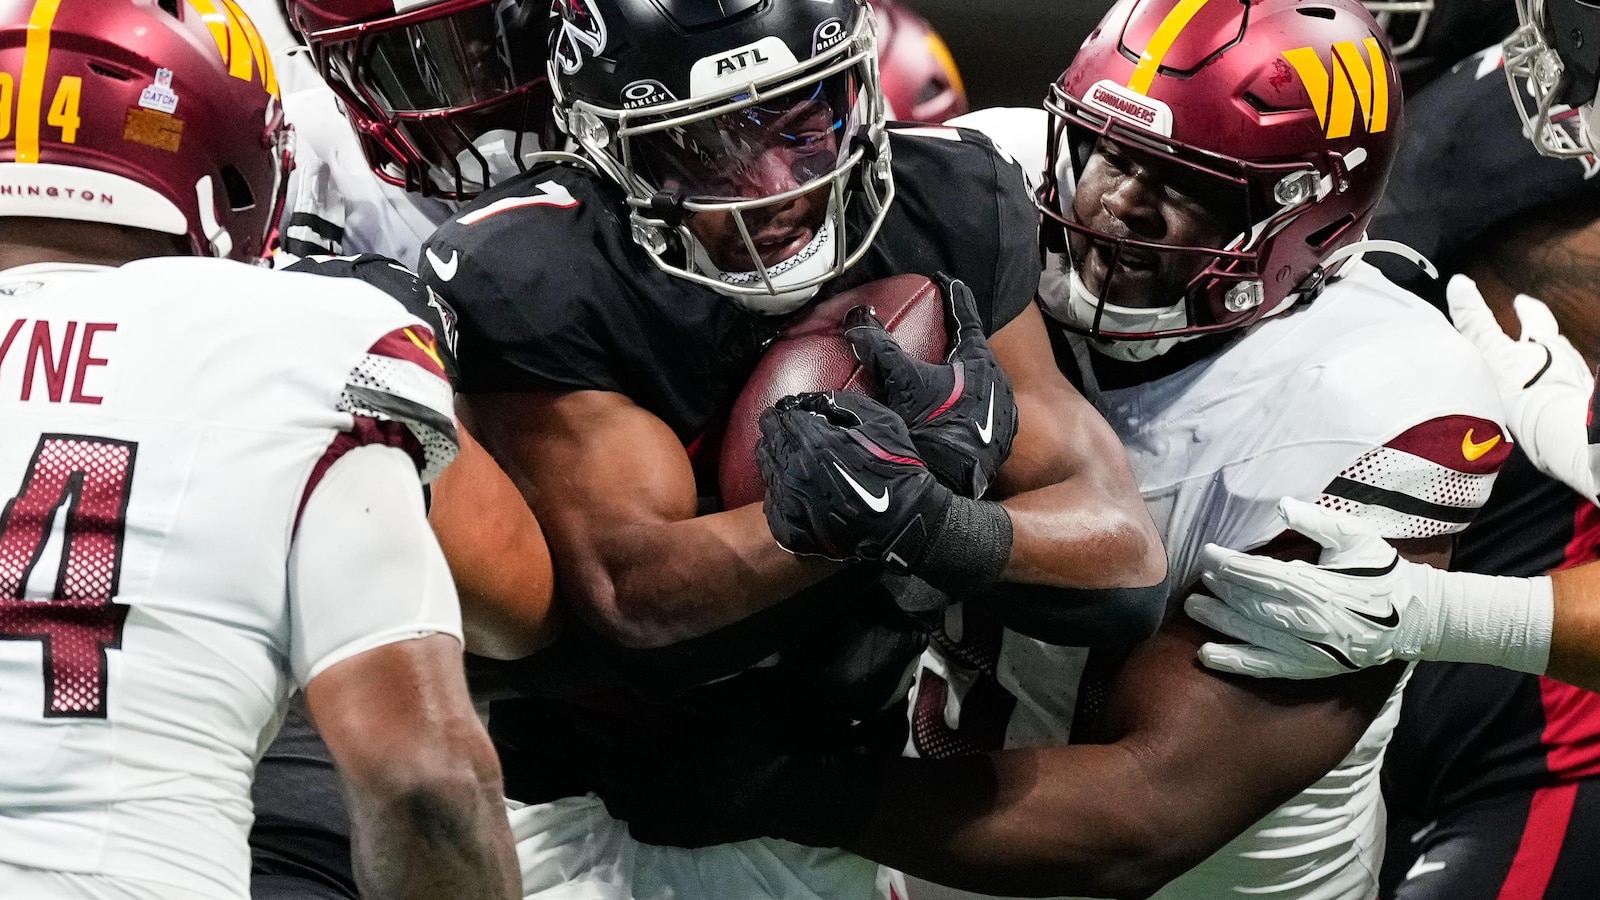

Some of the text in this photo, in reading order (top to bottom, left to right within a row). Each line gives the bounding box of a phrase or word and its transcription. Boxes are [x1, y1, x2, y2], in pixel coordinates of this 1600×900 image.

[816, 30, 847, 51] OAKLEY
[716, 48, 769, 76] ATL
[143, 90, 175, 105] CATCH
[623, 92, 666, 109] OAKLEY
[1092, 88, 1156, 123] COMMANDERS
[0, 185, 113, 204] HINGTON
